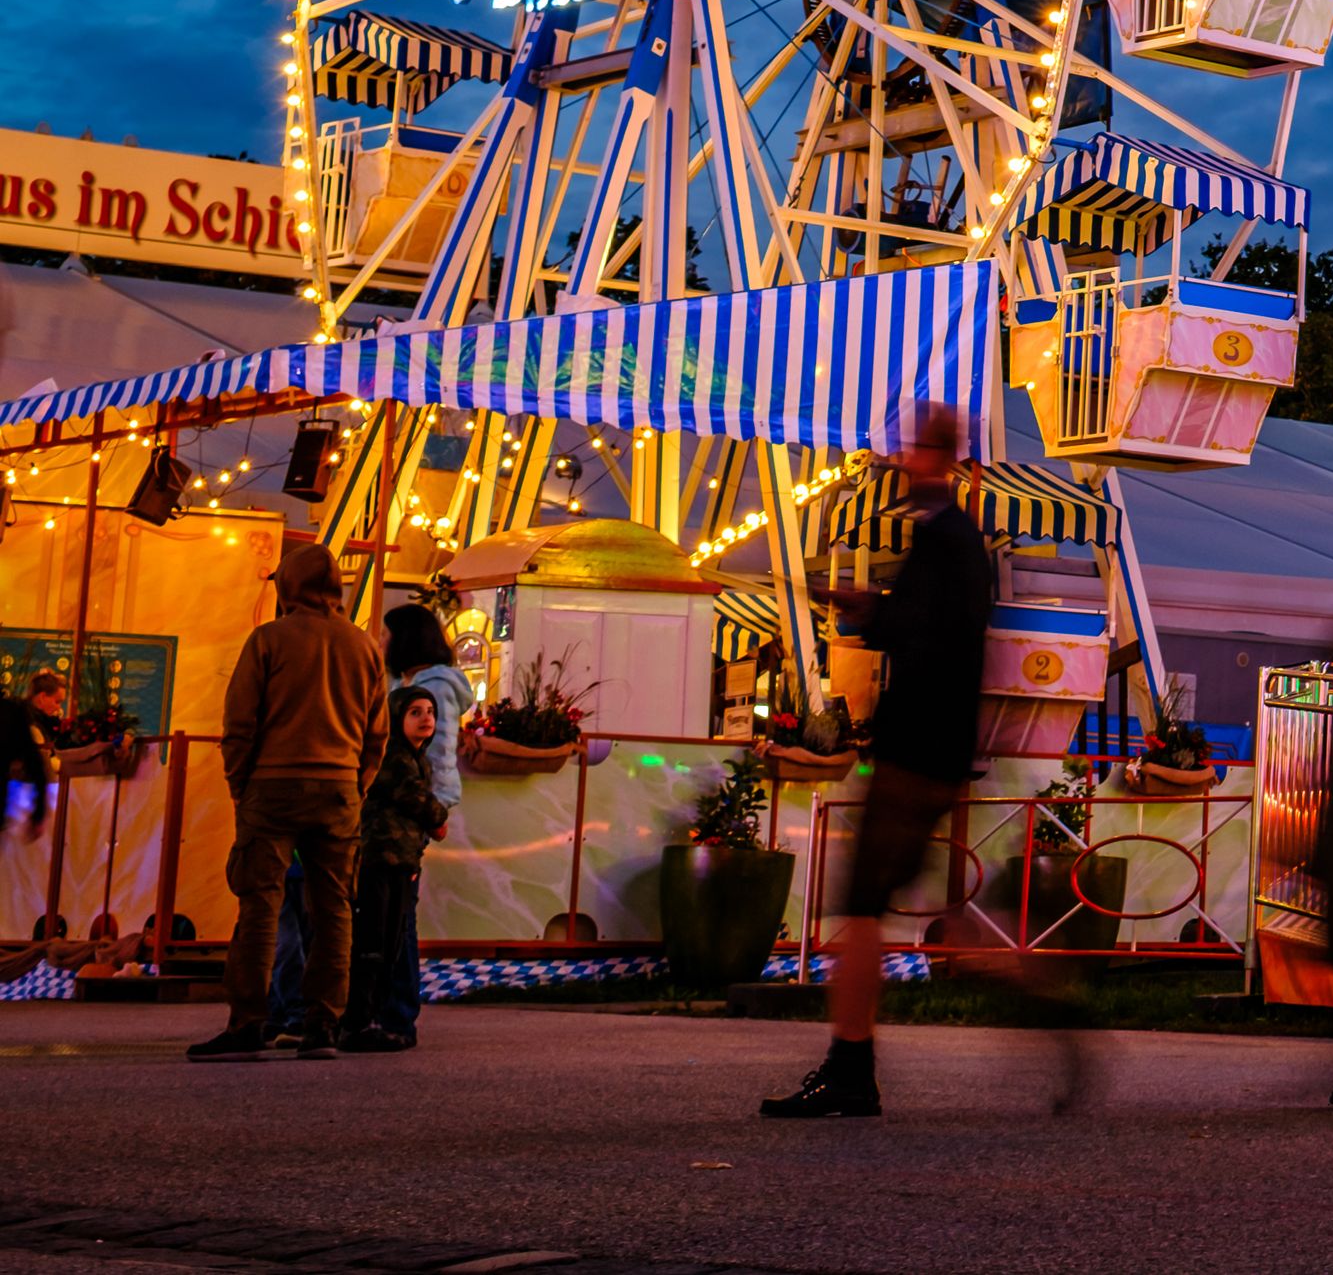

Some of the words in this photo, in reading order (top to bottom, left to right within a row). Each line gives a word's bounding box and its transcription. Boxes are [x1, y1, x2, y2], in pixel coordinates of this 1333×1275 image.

[75, 170, 147, 245] im
[1222, 335, 1240, 362] 3
[1034, 654, 1051, 680] 2
